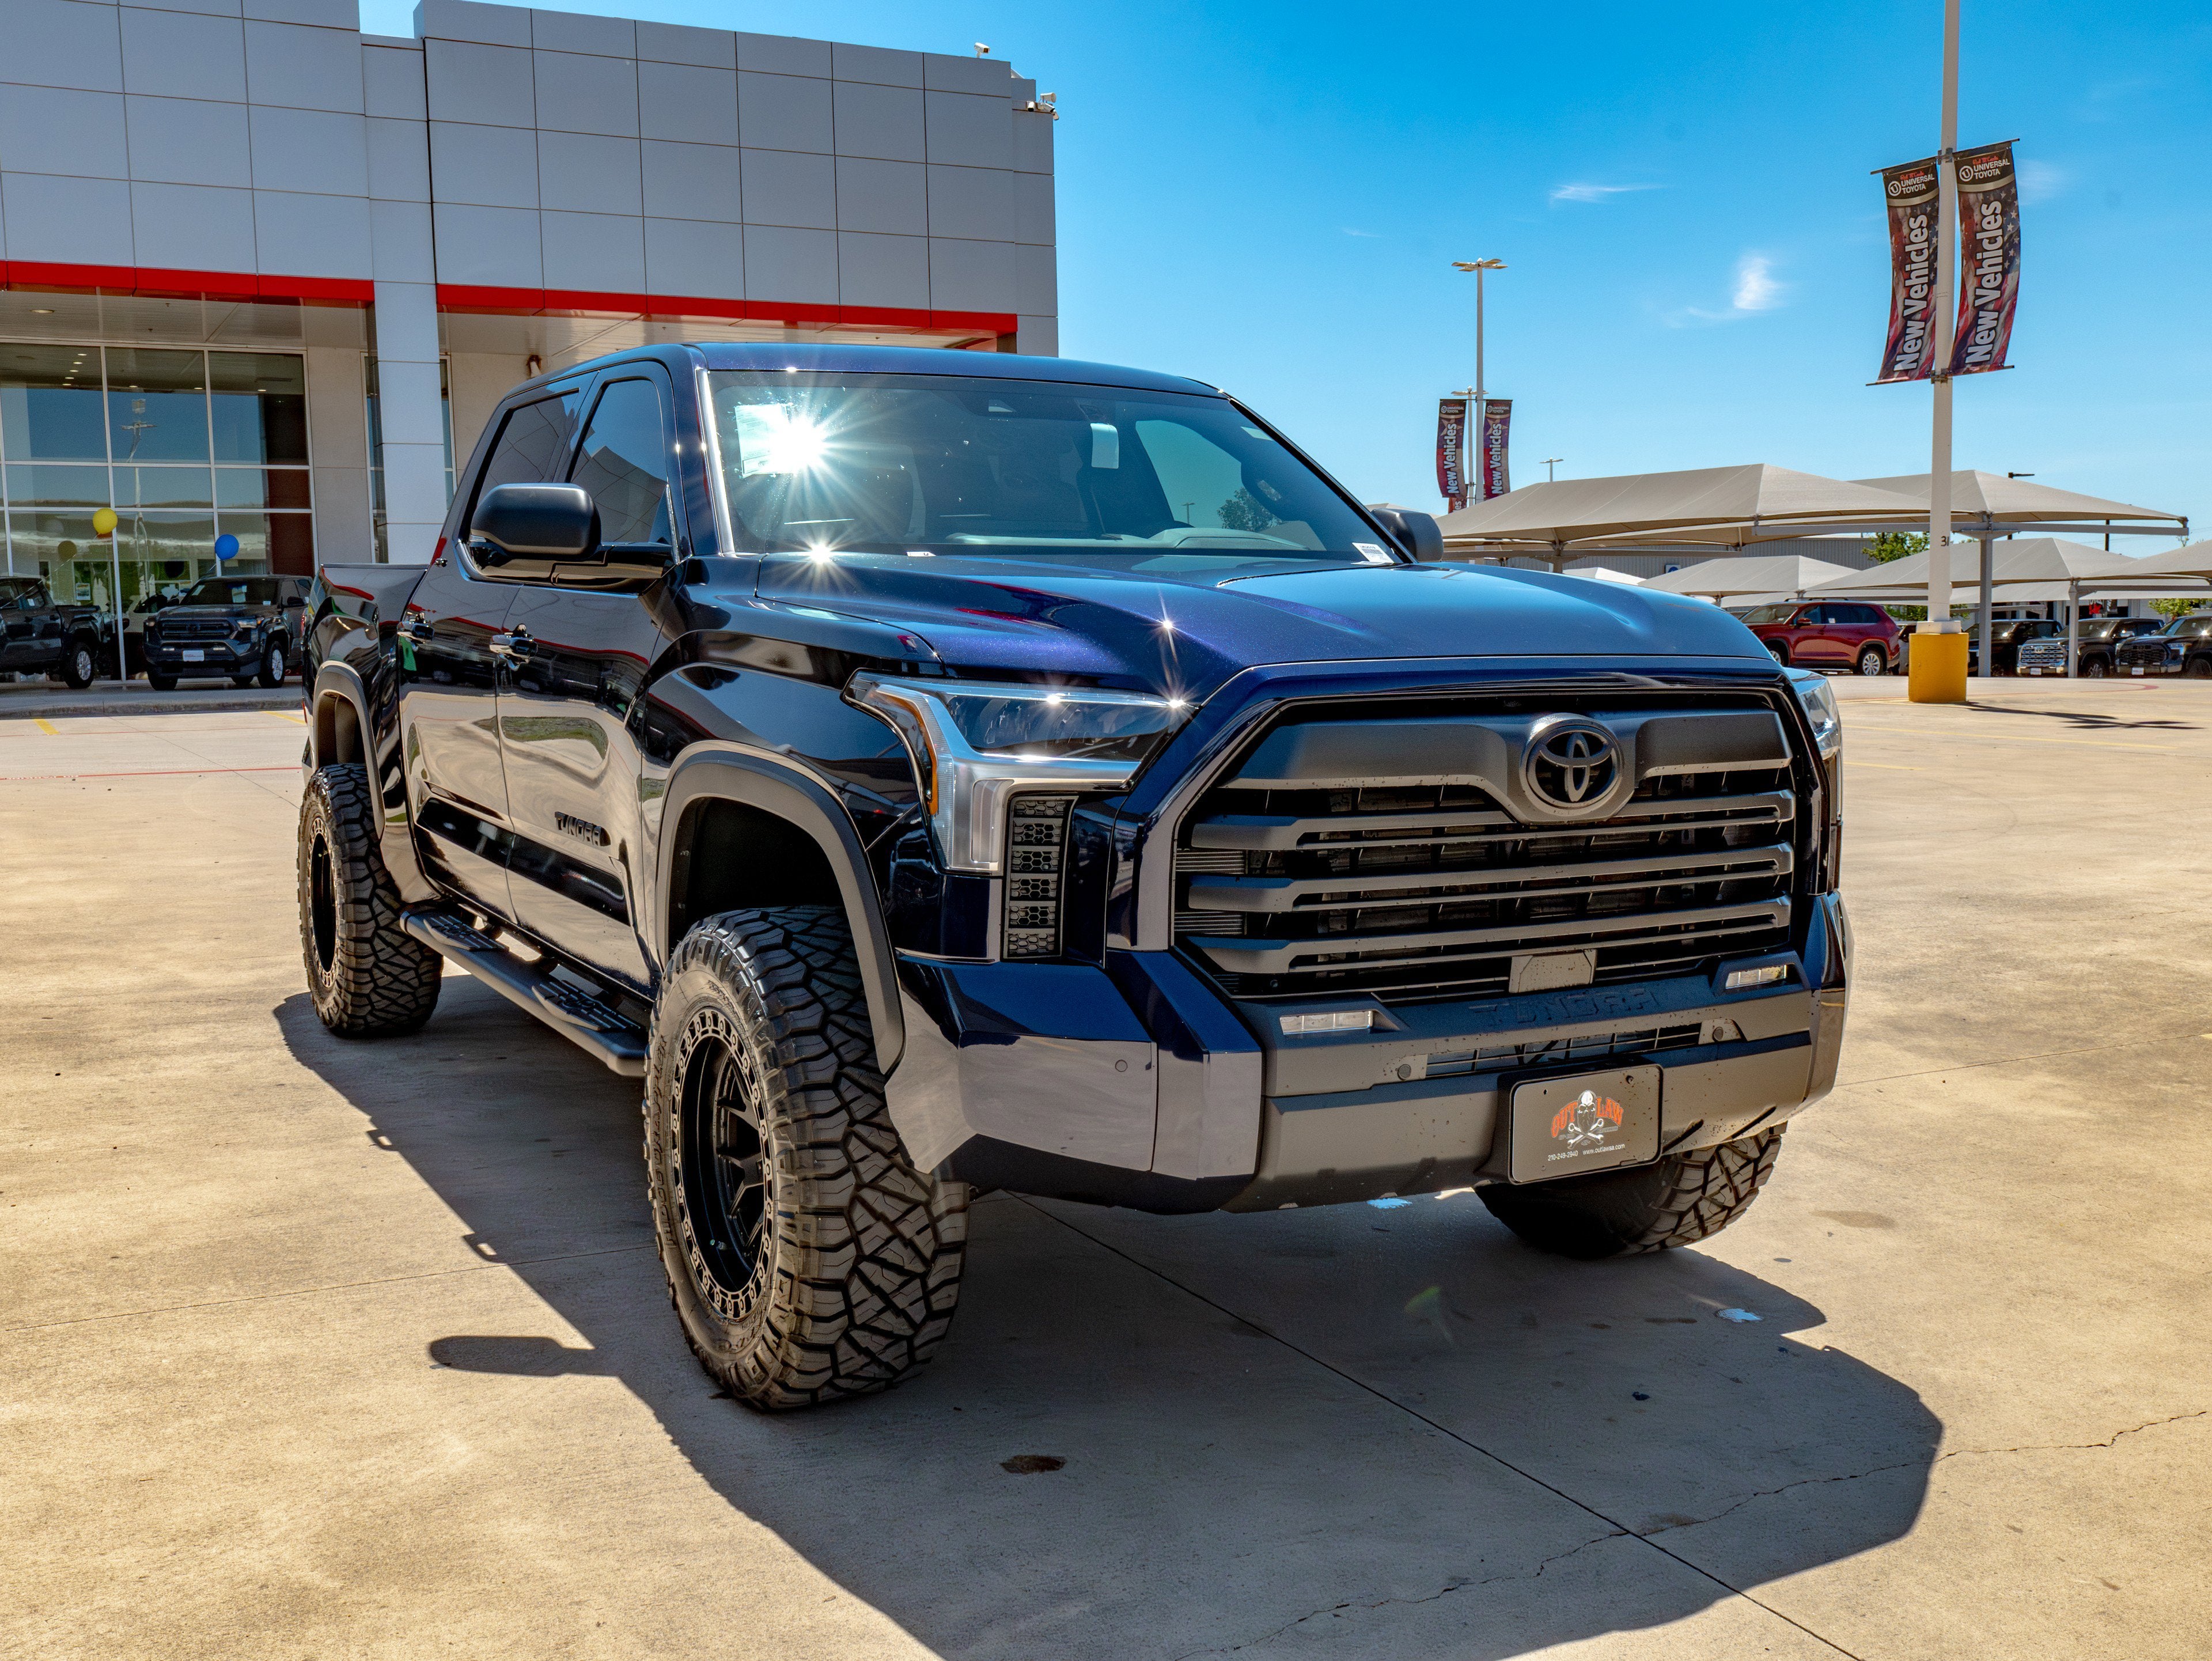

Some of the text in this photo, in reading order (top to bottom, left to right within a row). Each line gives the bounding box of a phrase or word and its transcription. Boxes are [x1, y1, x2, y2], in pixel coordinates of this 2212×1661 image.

[1901, 173, 1935, 187] UNIVERSAL
[1973, 158, 2010, 172] UNIVERSAL
[1974, 168, 2001, 179] TOYOTA
[1902, 183, 1926, 194] TOYOTA
[1903, 214, 1929, 317] Vehicles
[1974, 200, 2003, 307] Vehicles
[1893, 321, 1925, 372] New
[1965, 310, 1999, 364] New
[1444, 423, 1457, 469] Vehicles
[1489, 423, 1503, 494] New Vehicles
[1448, 471, 1460, 494] New
[554, 811, 601, 847] TUNDRA
[1548, 1144, 1625, 1161] 210-249-2940 www.outlawsa.com
